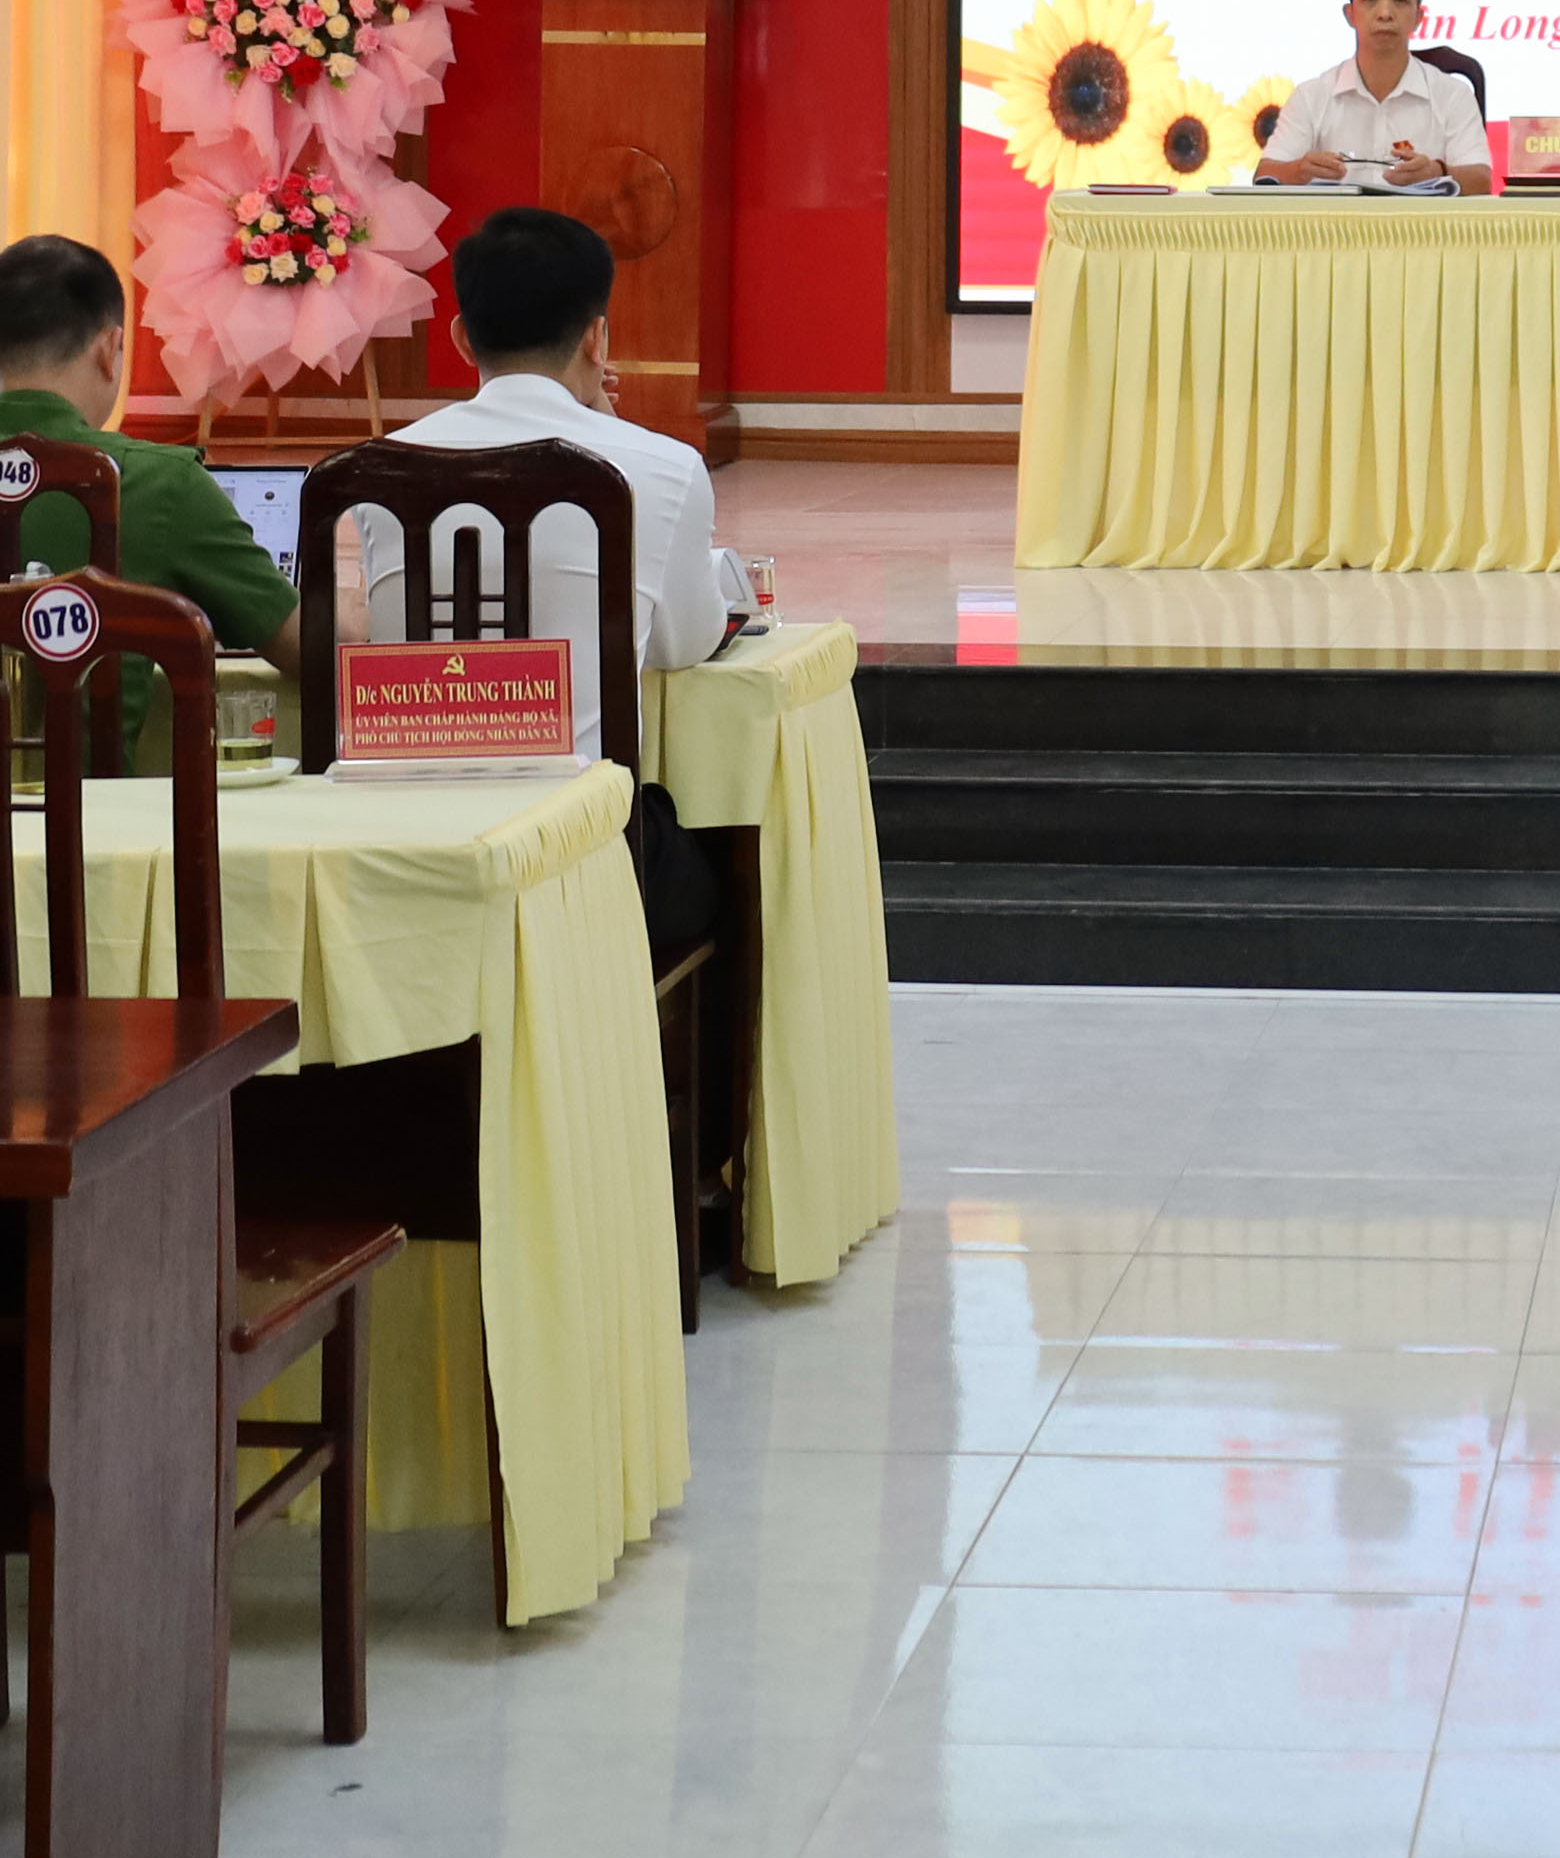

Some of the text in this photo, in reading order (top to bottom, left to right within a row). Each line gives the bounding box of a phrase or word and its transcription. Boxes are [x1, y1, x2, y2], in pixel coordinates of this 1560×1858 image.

[32, 603, 89, 640] 078
[356, 674, 556, 705] Đ/c NGUYỄN TRUNG THÀNH
